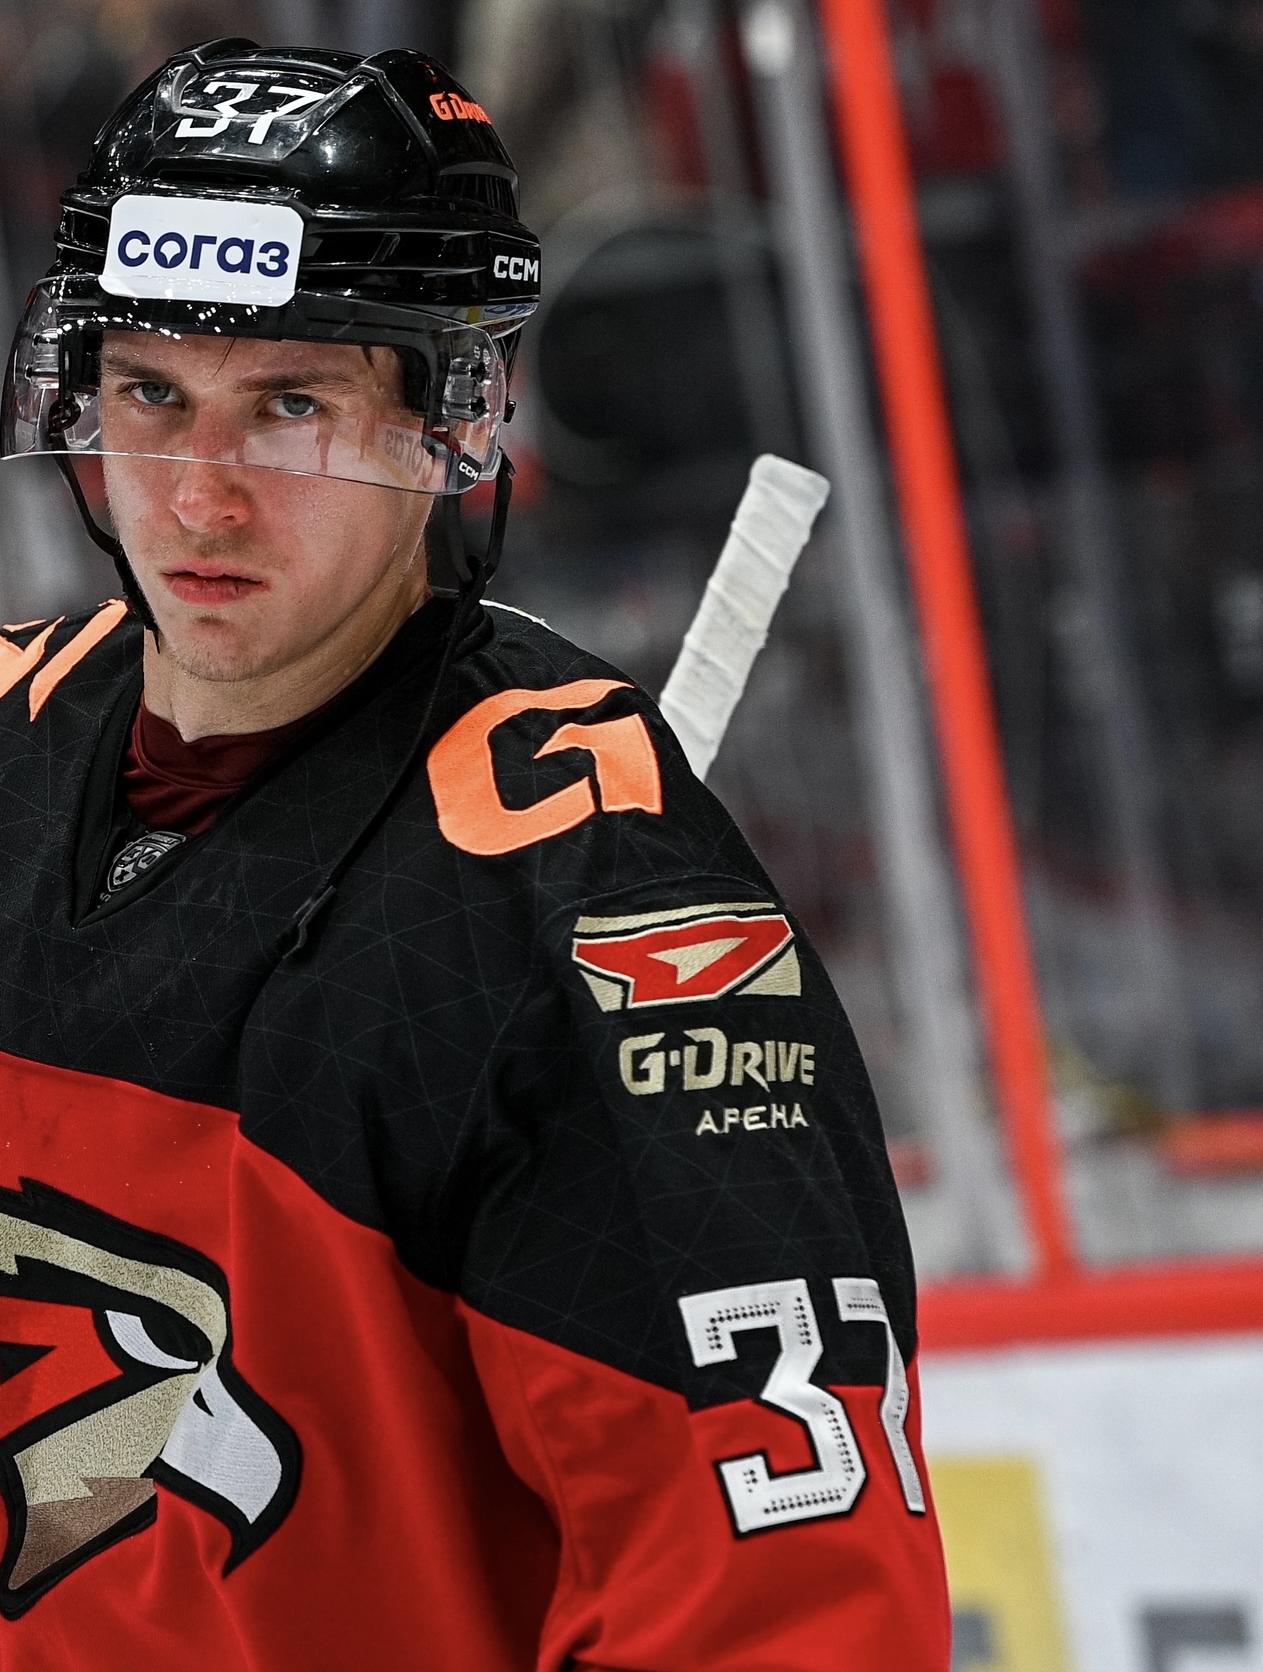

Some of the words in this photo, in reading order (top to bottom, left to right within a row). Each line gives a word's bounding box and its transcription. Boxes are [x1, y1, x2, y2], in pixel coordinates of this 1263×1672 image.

[174, 80, 333, 145] 37
[117, 229, 291, 278] согаз
[493, 255, 539, 282] CCM
[458, 461, 479, 481] CCM
[677, 1277, 927, 1534] 37
